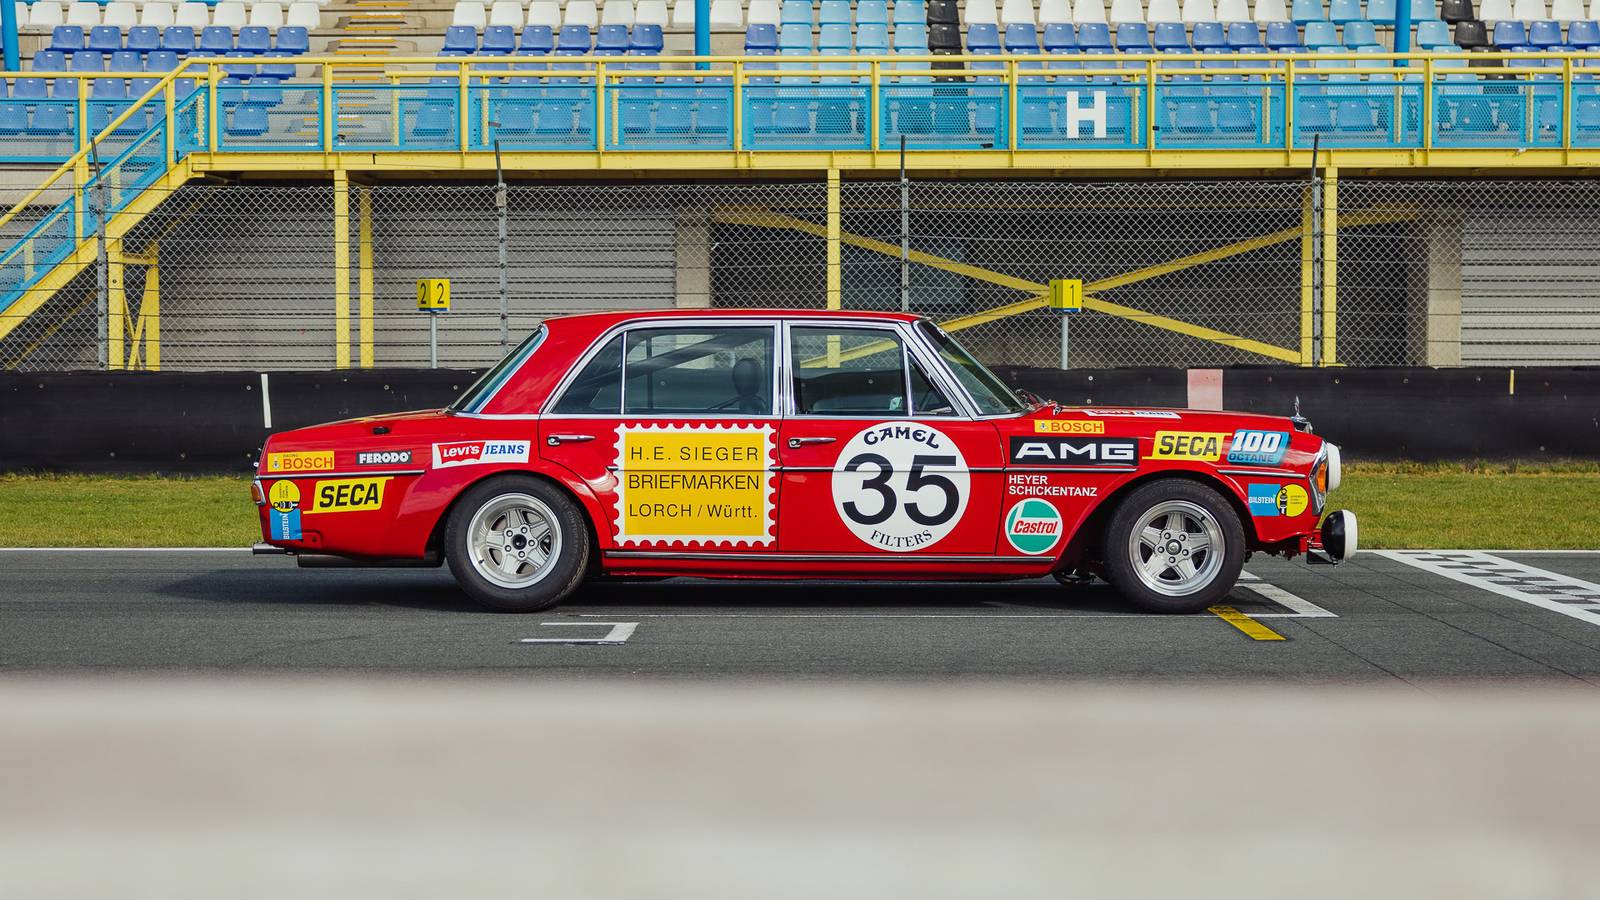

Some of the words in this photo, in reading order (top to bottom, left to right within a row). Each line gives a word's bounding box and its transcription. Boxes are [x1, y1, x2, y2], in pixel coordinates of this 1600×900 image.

[1067, 91, 1106, 138] H
[420, 282, 426, 304] 2
[437, 282, 444, 304] 2
[1051, 422, 1103, 432] BOSCH
[863, 426, 939, 449] CAMEL
[1231, 431, 1282, 453] 100
[484, 444, 525, 455] JEANS
[1015, 442, 1134, 460] AMG
[1158, 435, 1218, 456] SECA
[359, 451, 409, 464] FERODO
[680, 446, 758, 461] SIEGER
[1228, 453, 1274, 463] OCTANE
[283, 457, 333, 469] BOSCH
[628, 474, 760, 490] BRIEFMARKEN
[1008, 474, 1048, 485] HEYER
[319, 482, 379, 508] SECA
[842, 452, 960, 526] 35
[1008, 485, 1098, 497] SCHICKENTANZ
[1248, 496, 1276, 504] BILSTEIN
[629, 503, 692, 517] LORCH
[707, 504, 758, 518] Württ.
[1013, 520, 1059, 534] Castrol
[870, 529, 932, 548] FILTERS
